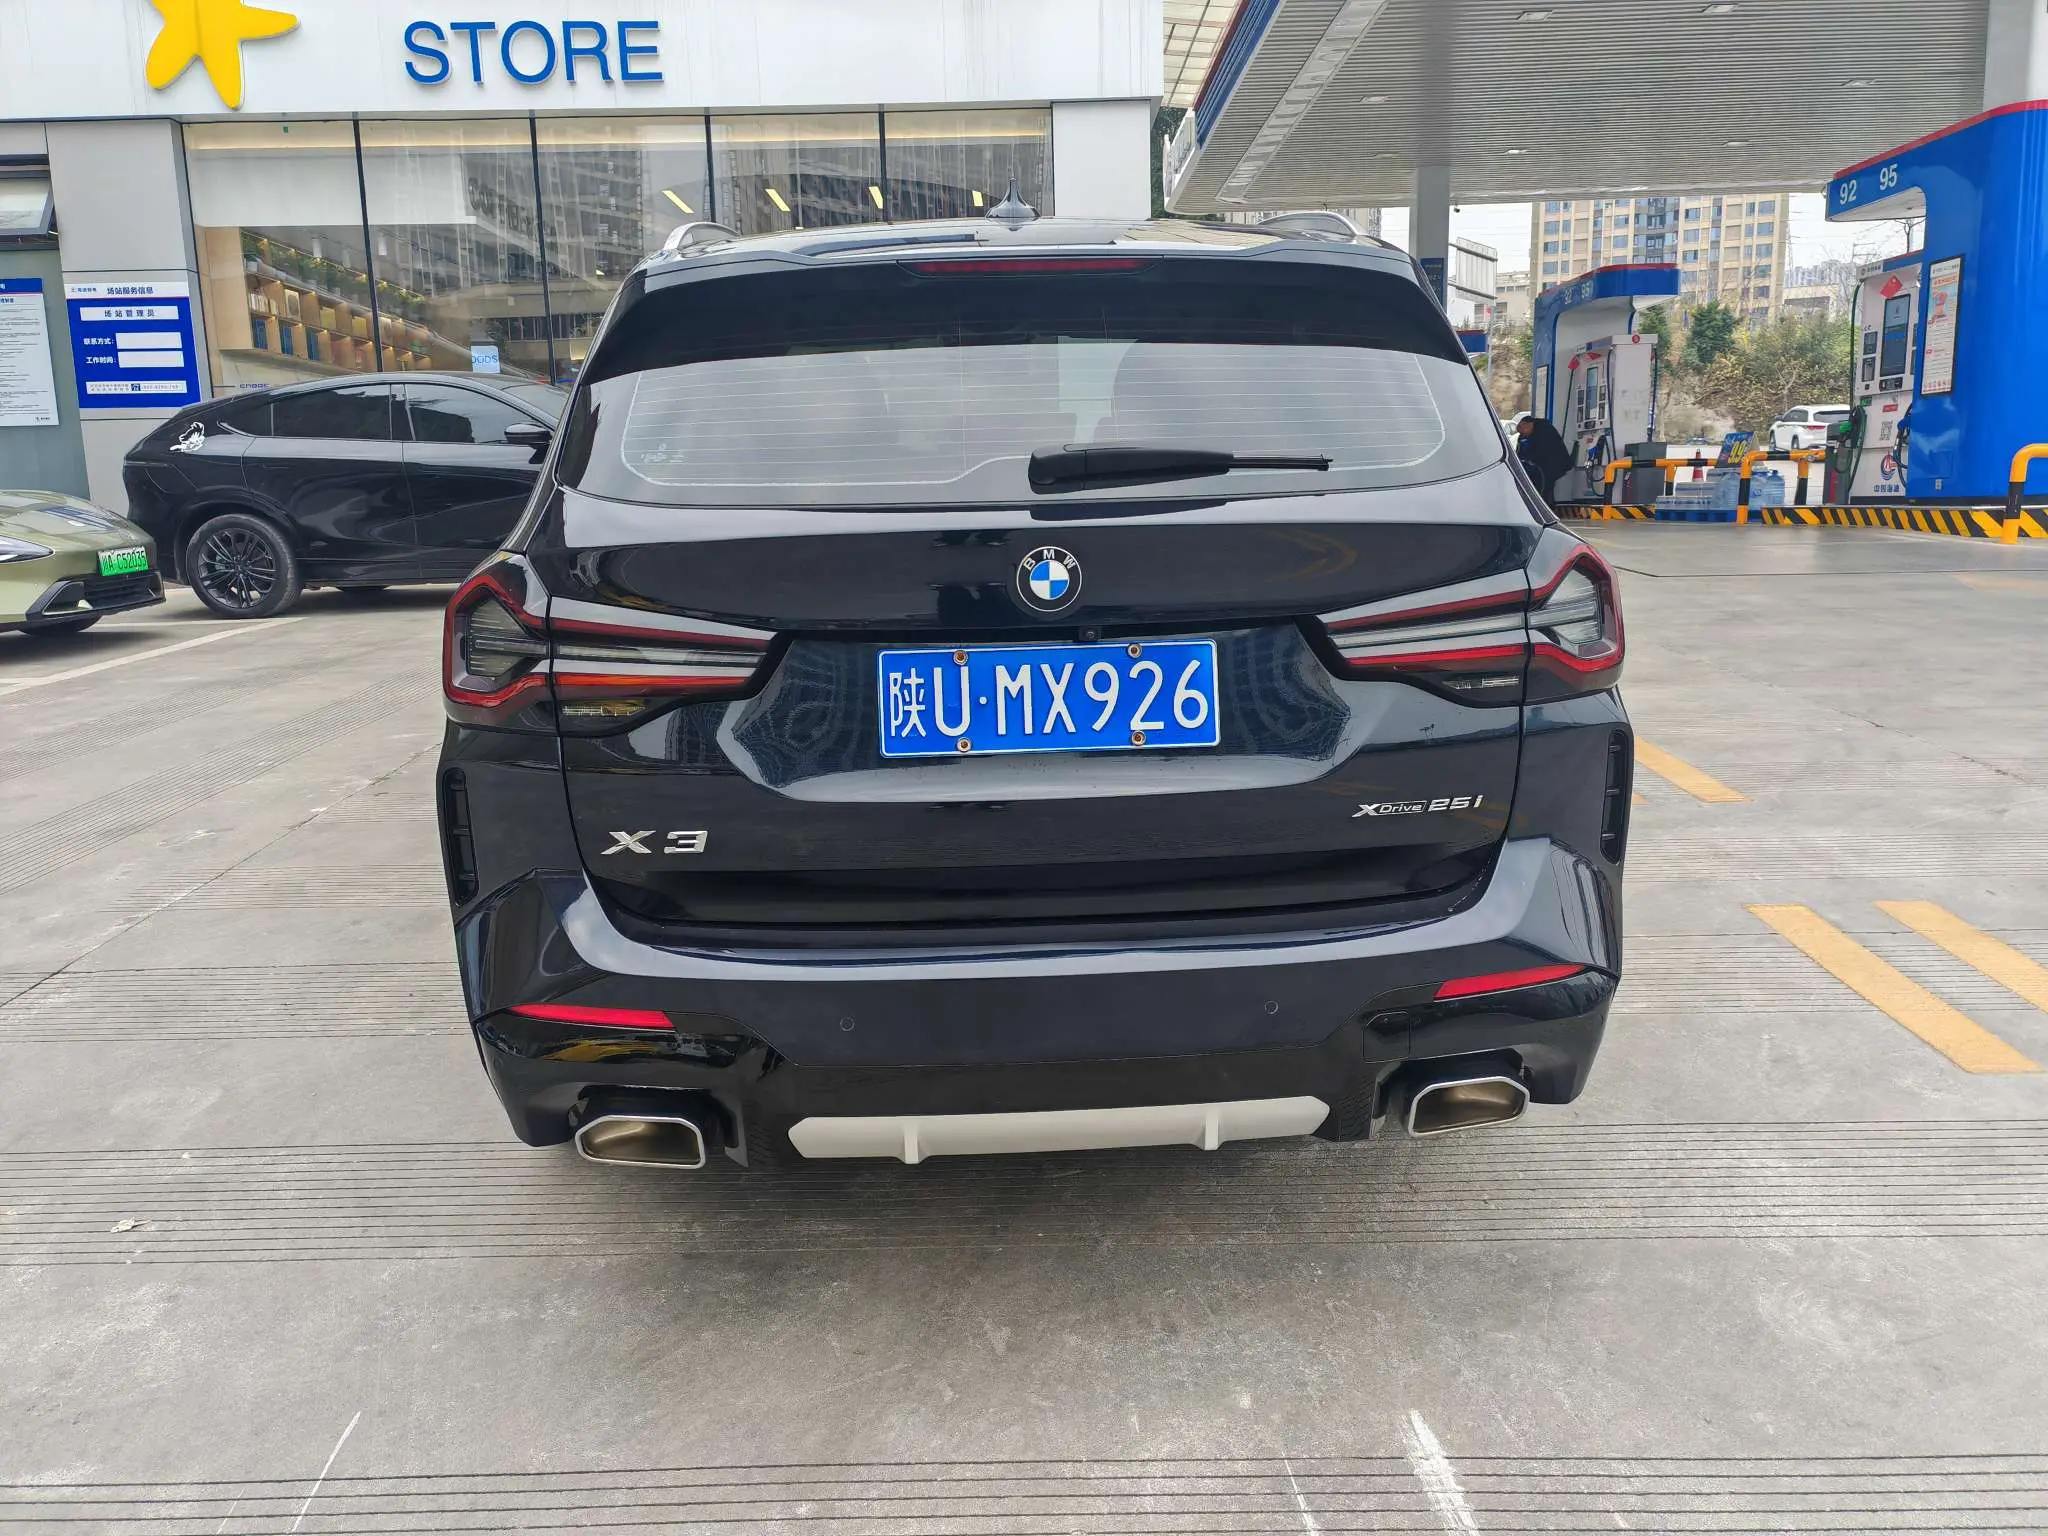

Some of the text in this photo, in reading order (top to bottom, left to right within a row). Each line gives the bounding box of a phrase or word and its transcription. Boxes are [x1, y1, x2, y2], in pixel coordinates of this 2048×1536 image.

[404, 20, 664, 85] STORE
[1840, 163, 1898, 205] 92 95
[107, 286, 154, 295] 场站服务信息
[104, 309, 155, 318] 场站管理员
[1023, 549, 1076, 573] BMW
[889, 659, 1209, 738] 陕U·MX926
